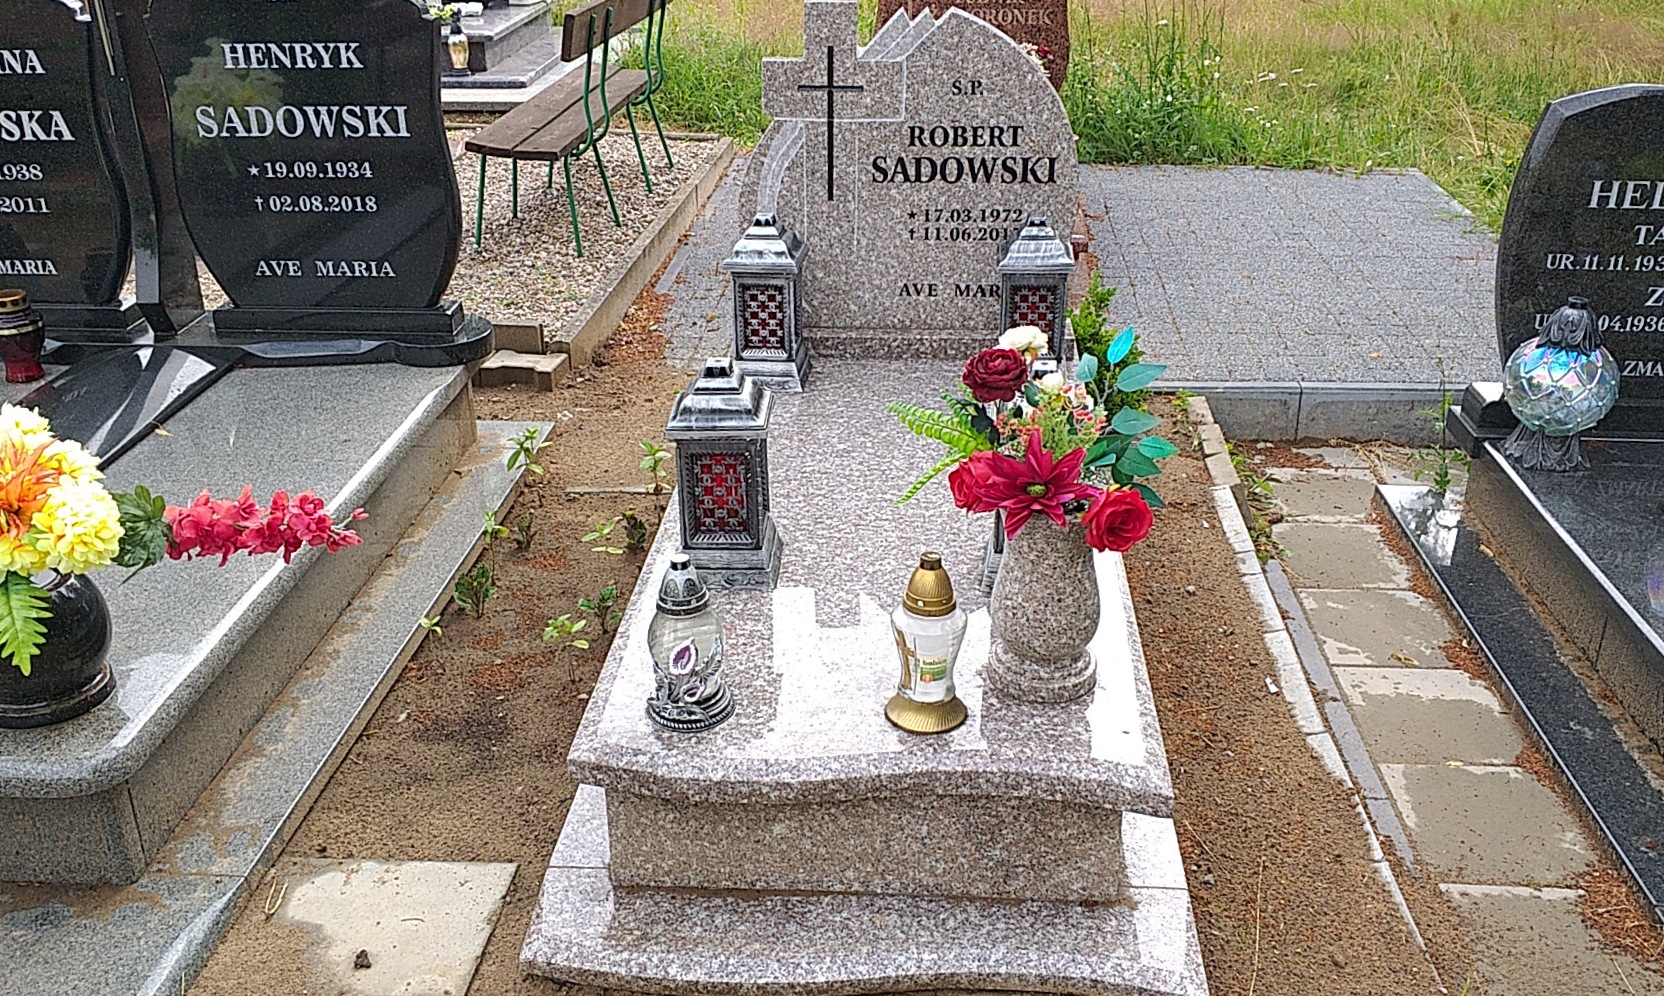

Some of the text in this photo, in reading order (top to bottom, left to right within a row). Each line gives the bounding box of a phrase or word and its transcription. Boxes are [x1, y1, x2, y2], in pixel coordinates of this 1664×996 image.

[0, 49, 46, 74] NA
[221, 42, 364, 69] HENRYK
[0, 110, 76, 141] SKA
[195, 105, 411, 138] SADOWSKI
[907, 125, 1025, 148] ROBERT
[0, 164, 43, 181] 938
[264, 161, 374, 178] 19.09.1934
[872, 155, 1060, 184] SADOWSKI
[0, 196, 51, 213] 2011
[269, 195, 378, 212] 02.08.2018
[924, 208, 1023, 223] 17.03.1972
[255, 260, 396, 277] AVE MARIA
[899, 283, 1001, 298] AVE MAR
